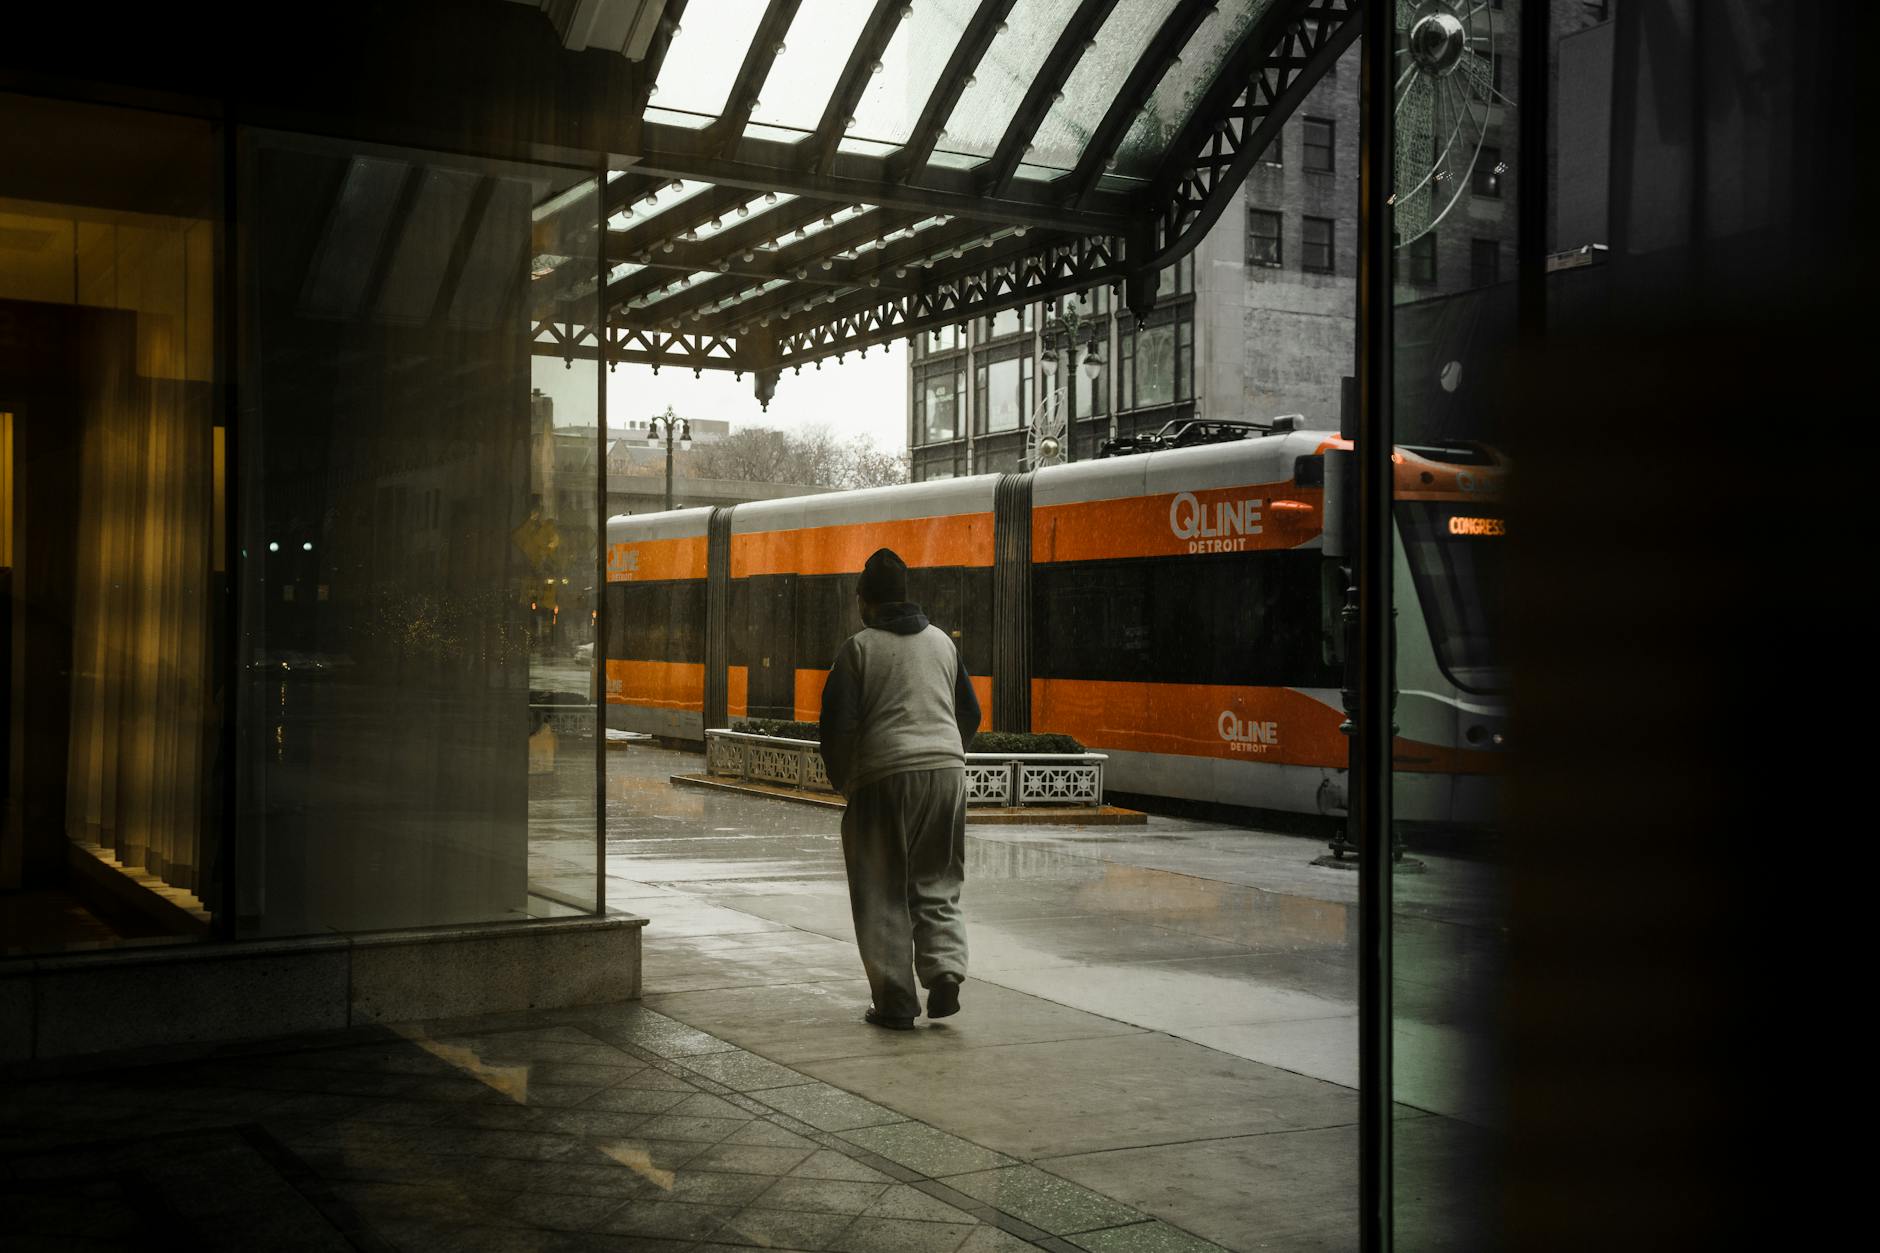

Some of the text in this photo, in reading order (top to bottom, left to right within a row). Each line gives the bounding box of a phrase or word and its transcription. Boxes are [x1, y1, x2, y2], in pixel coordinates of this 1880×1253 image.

[1169, 491, 1264, 540] QLINE
[1448, 516, 1505, 536] CONGRESS
[1188, 538, 1247, 554] DETROIT
[1218, 710, 1278, 745] QLINE
[1230, 741, 1268, 753] DETROIT
